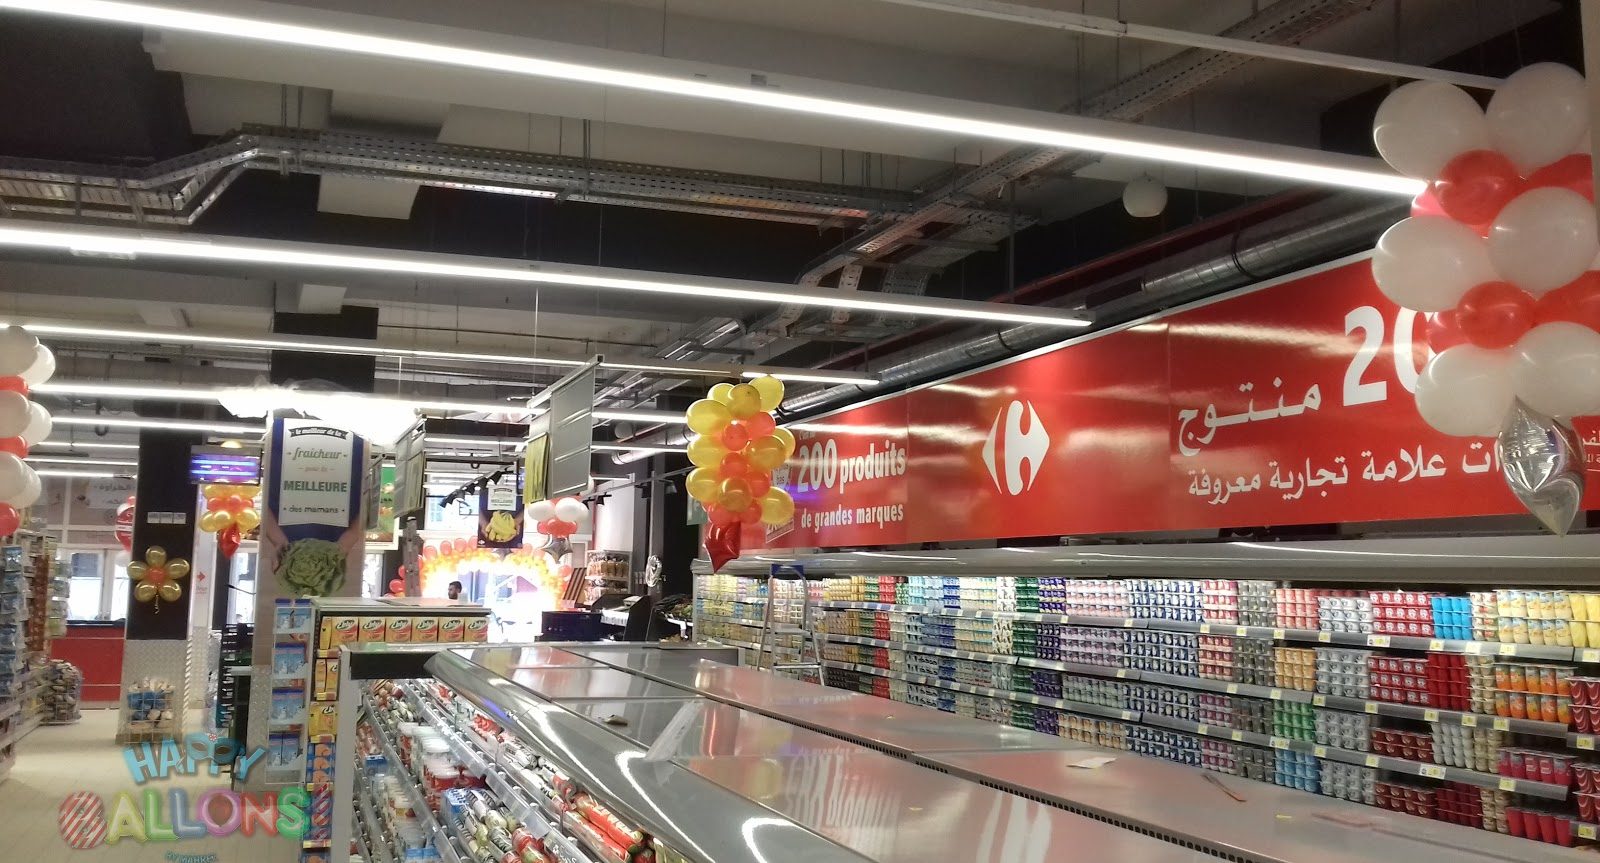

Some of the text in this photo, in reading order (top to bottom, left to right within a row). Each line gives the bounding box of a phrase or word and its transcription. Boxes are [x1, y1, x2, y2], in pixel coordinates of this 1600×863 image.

[1177, 375, 1322, 457] منتوج
[797, 439, 906, 494] 200 produits
[1270, 456, 1349, 500] تجارية
[1362, 444, 1447, 483] علامة
[283, 480, 347, 492] MEILLEURE
[1188, 468, 1261, 505] معروفة
[288, 504, 302, 513] des
[802, 507, 811, 528] de
[814, 504, 853, 533] grandes
[856, 503, 904, 529] marques
